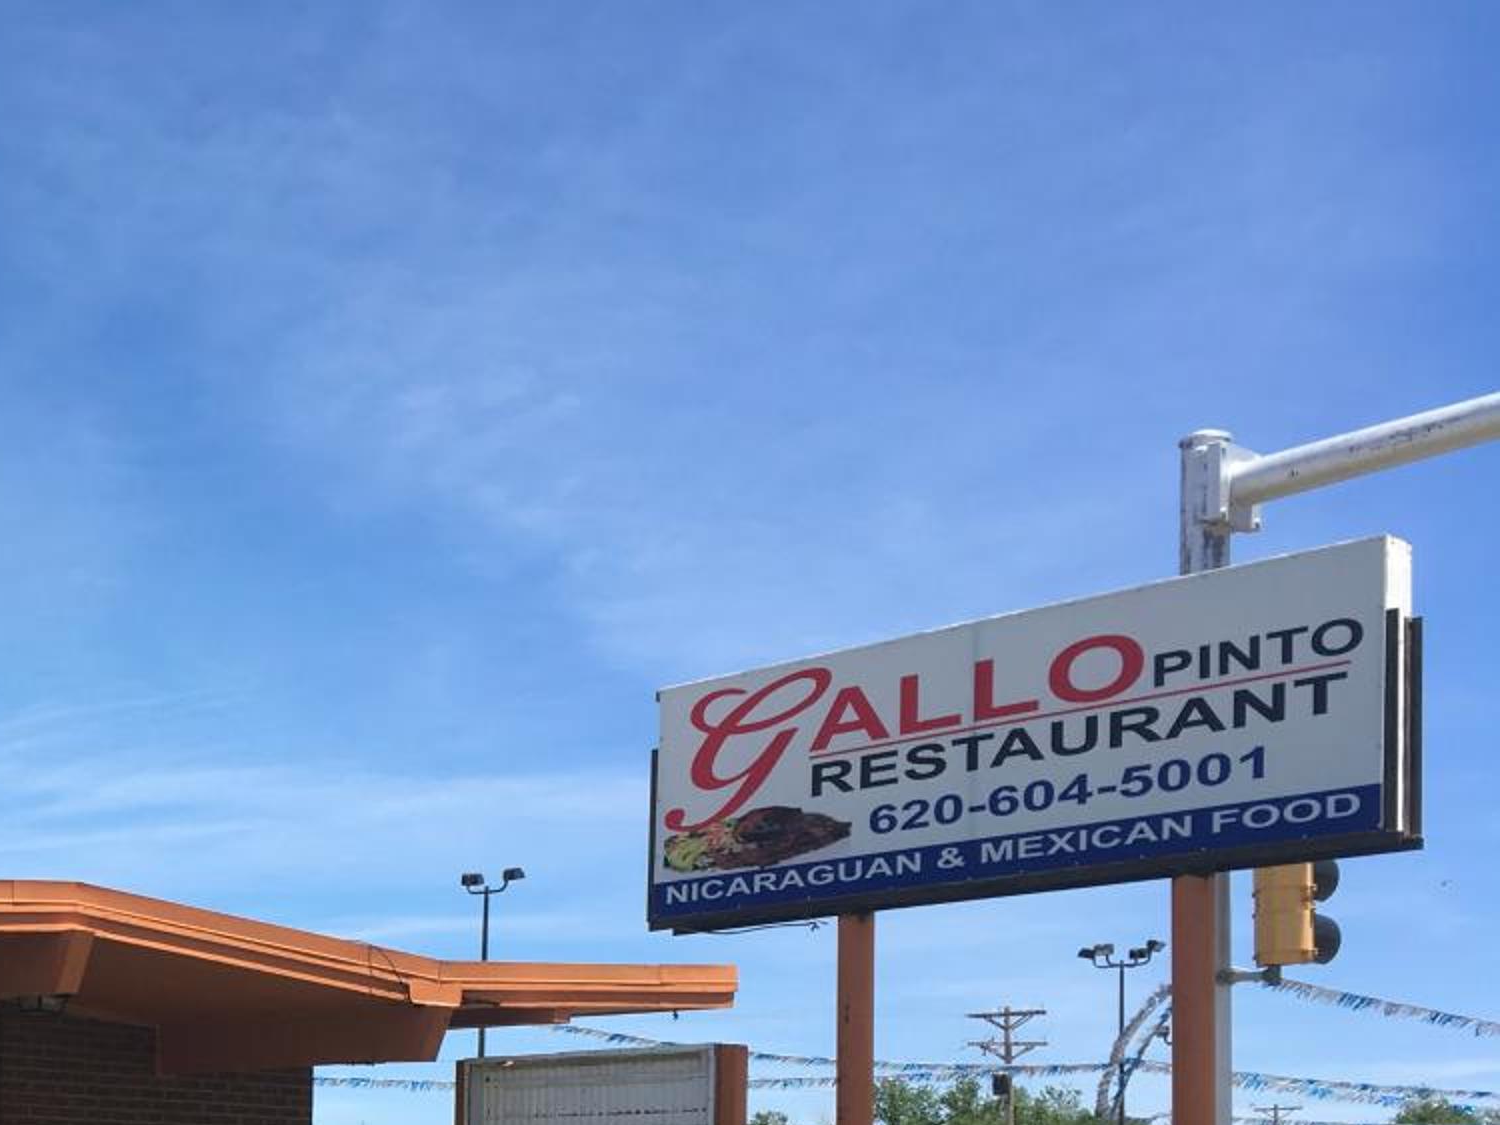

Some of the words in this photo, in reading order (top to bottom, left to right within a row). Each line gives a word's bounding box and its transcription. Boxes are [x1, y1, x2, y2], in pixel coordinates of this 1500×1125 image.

[664, 634, 1145, 831] GALLO
[1153, 617, 1365, 687] PINTO
[810, 671, 1348, 797] RESTAURANT
[666, 853, 922, 905] NICARAGUAN
[937, 847, 965, 871] &
[981, 815, 1193, 864] MEXICAN
[1213, 793, 1362, 833] FOOD
[869, 746, 1267, 835] 620-604-5001
